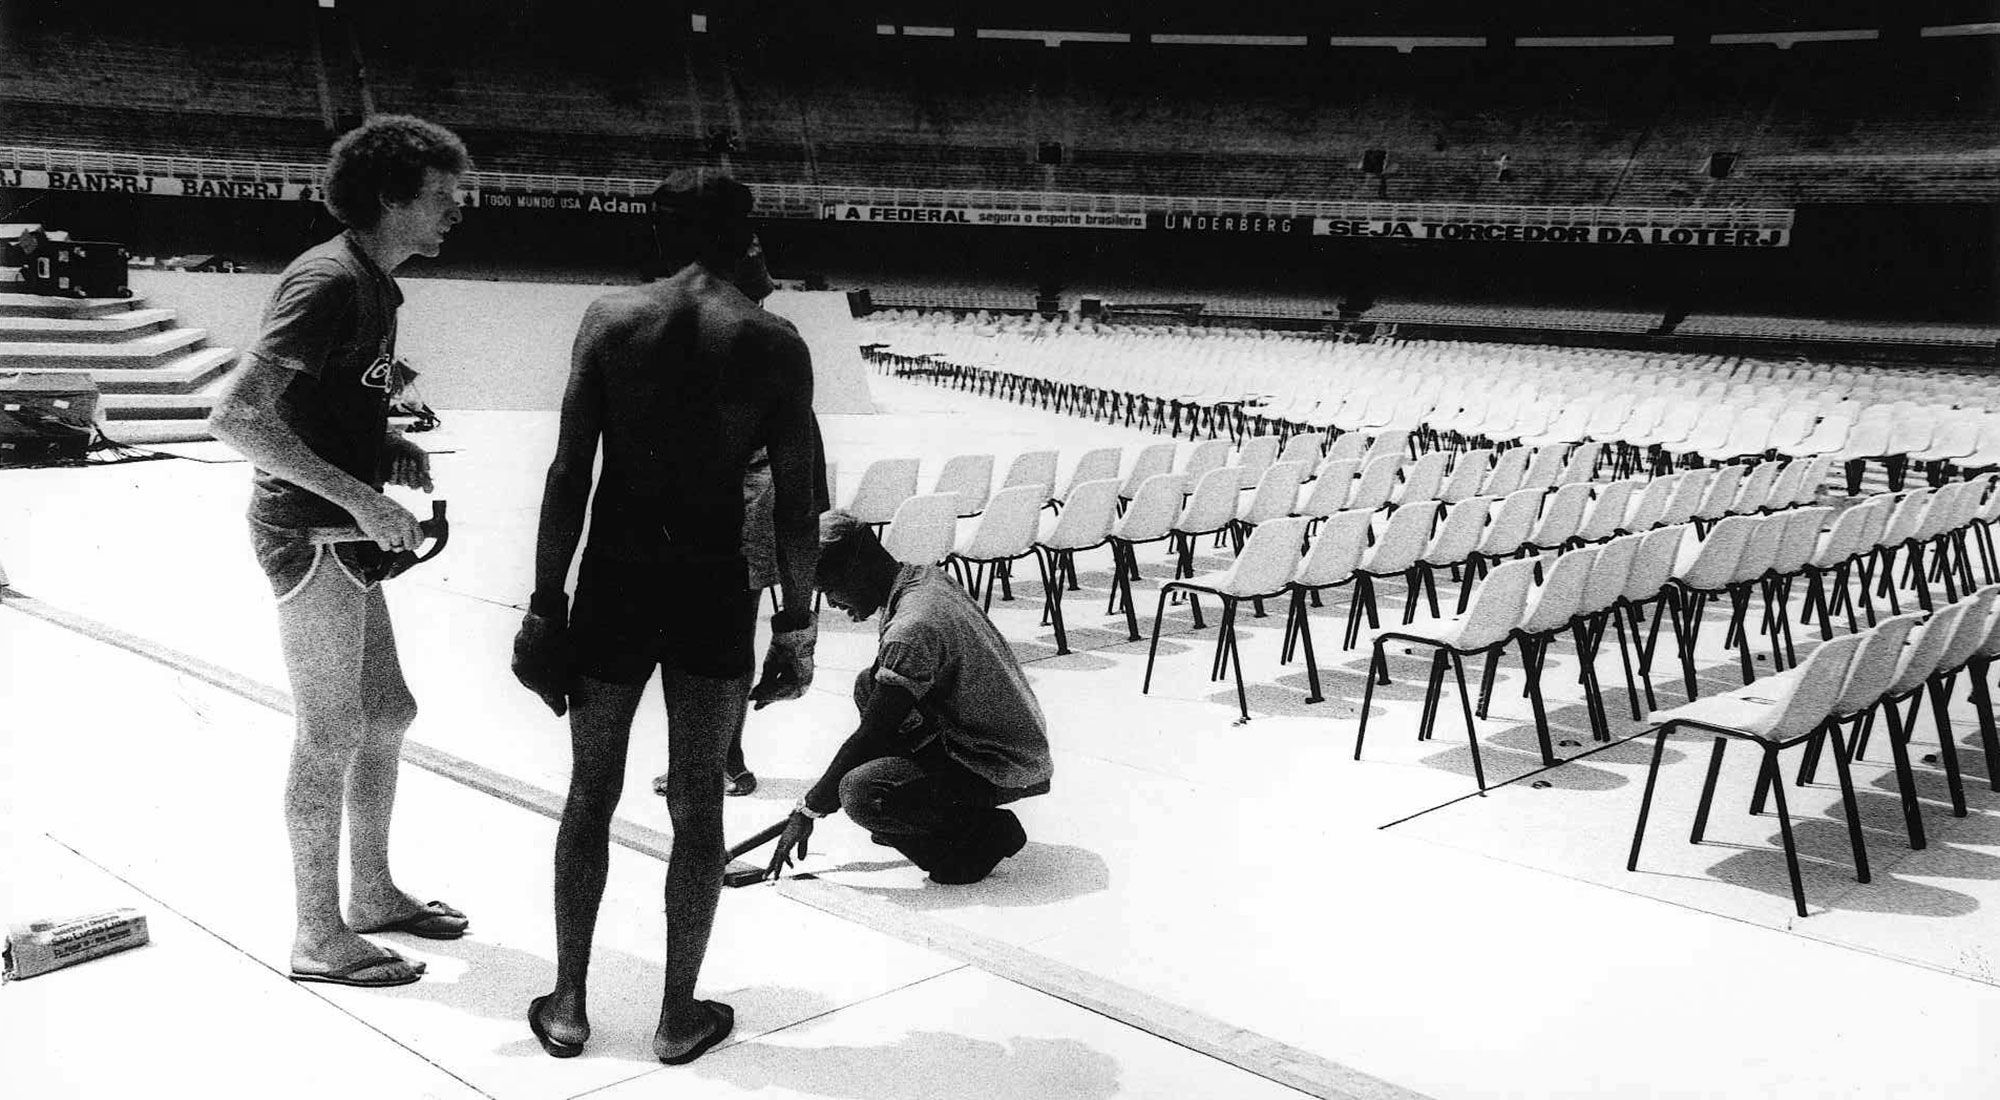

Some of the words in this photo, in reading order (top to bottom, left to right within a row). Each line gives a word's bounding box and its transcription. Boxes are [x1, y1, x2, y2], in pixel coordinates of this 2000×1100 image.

[47, 171, 153, 193] BANERJ
[181, 178, 283, 199] BANERJ
[517, 195, 555, 209] MUNDO
[560, 197, 581, 209] USA
[845, 207, 860, 220] A
[869, 207, 970, 223] FEDERAL
[978, 212, 1020, 224] segura
[1024, 214, 1032, 223] o
[1036, 214, 1081, 225] esporte
[1165, 212, 1291, 233] UNDERBERG
[1328, 220, 1413, 238] SEJA
[1421, 223, 1590, 243] TORCEDOR
[1598, 227, 1643, 244] DA
[1652, 228, 1781, 246] LOTERJ
